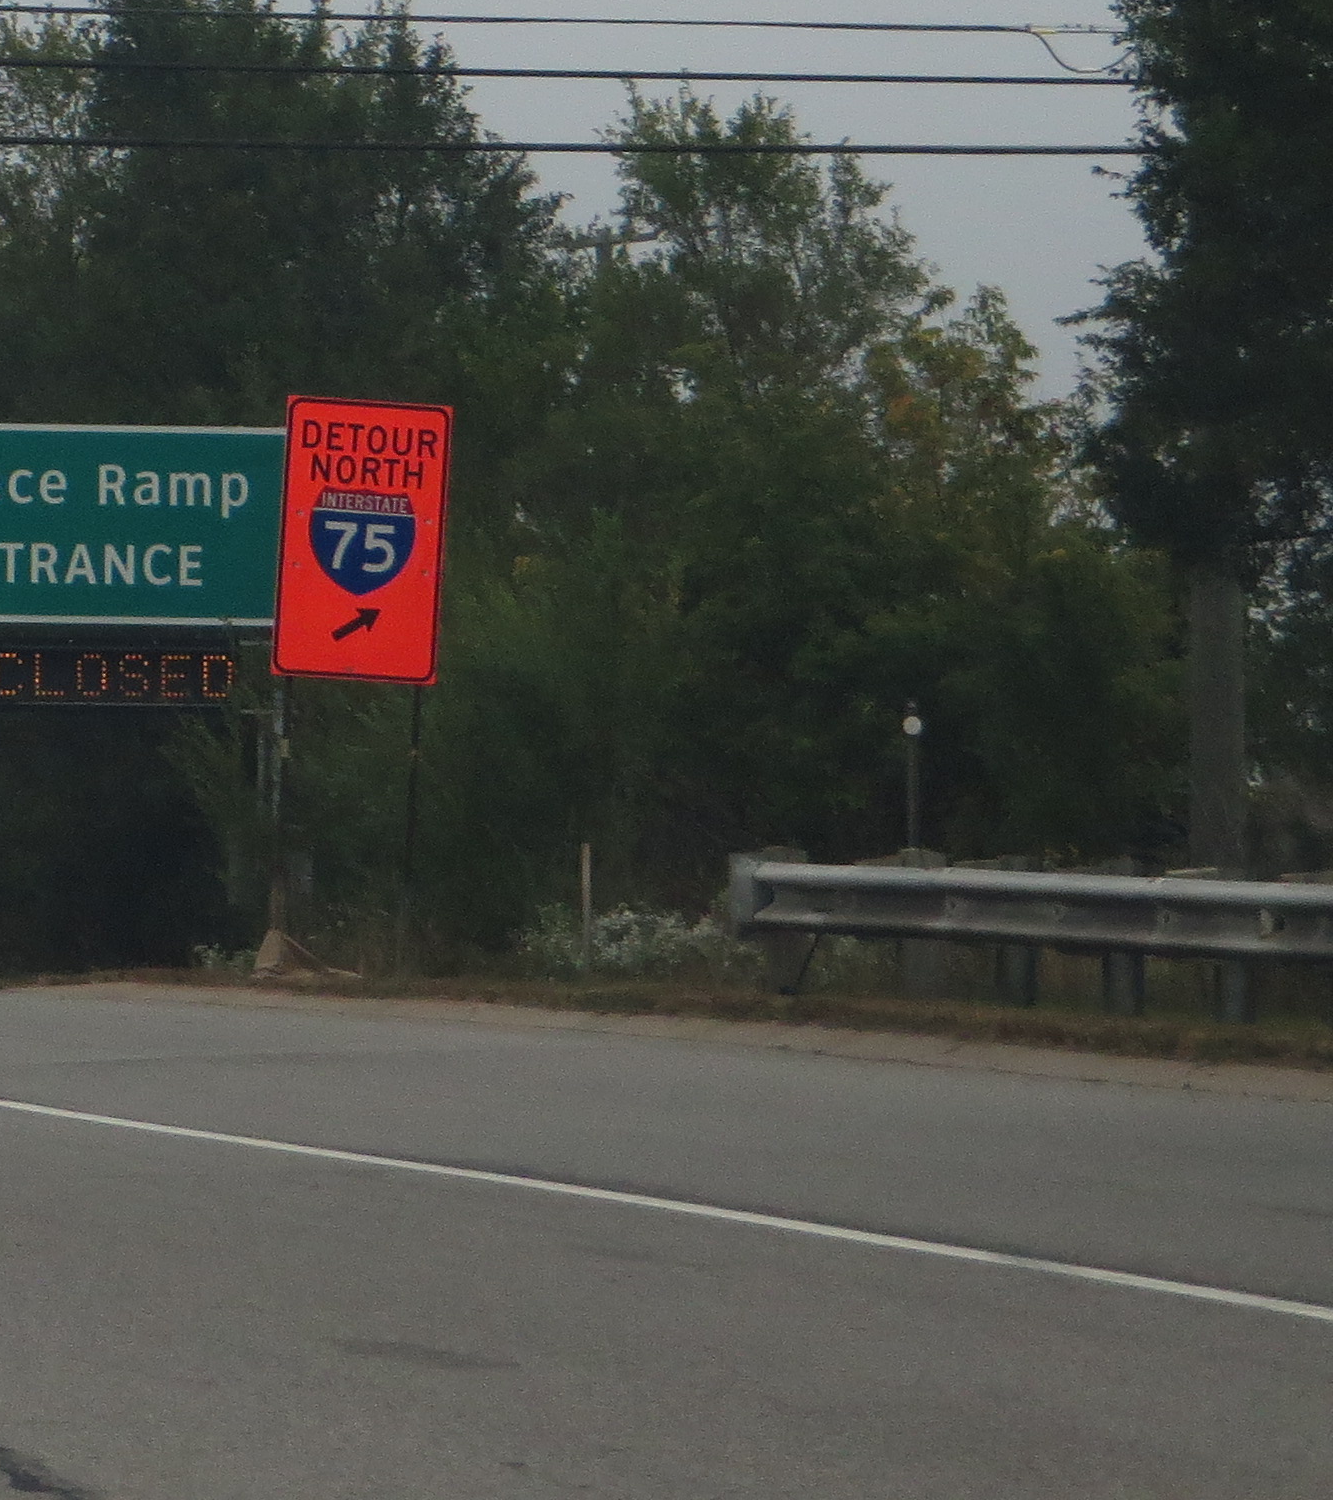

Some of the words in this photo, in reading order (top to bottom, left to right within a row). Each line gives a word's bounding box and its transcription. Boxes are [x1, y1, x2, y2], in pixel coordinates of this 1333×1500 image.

[301, 419, 438, 459] DETOUR
[96, 463, 250, 519] Ramp
[310, 453, 424, 490] NORTH
[321, 491, 409, 514] INTERSTATE
[324, 520, 397, 573] 75
